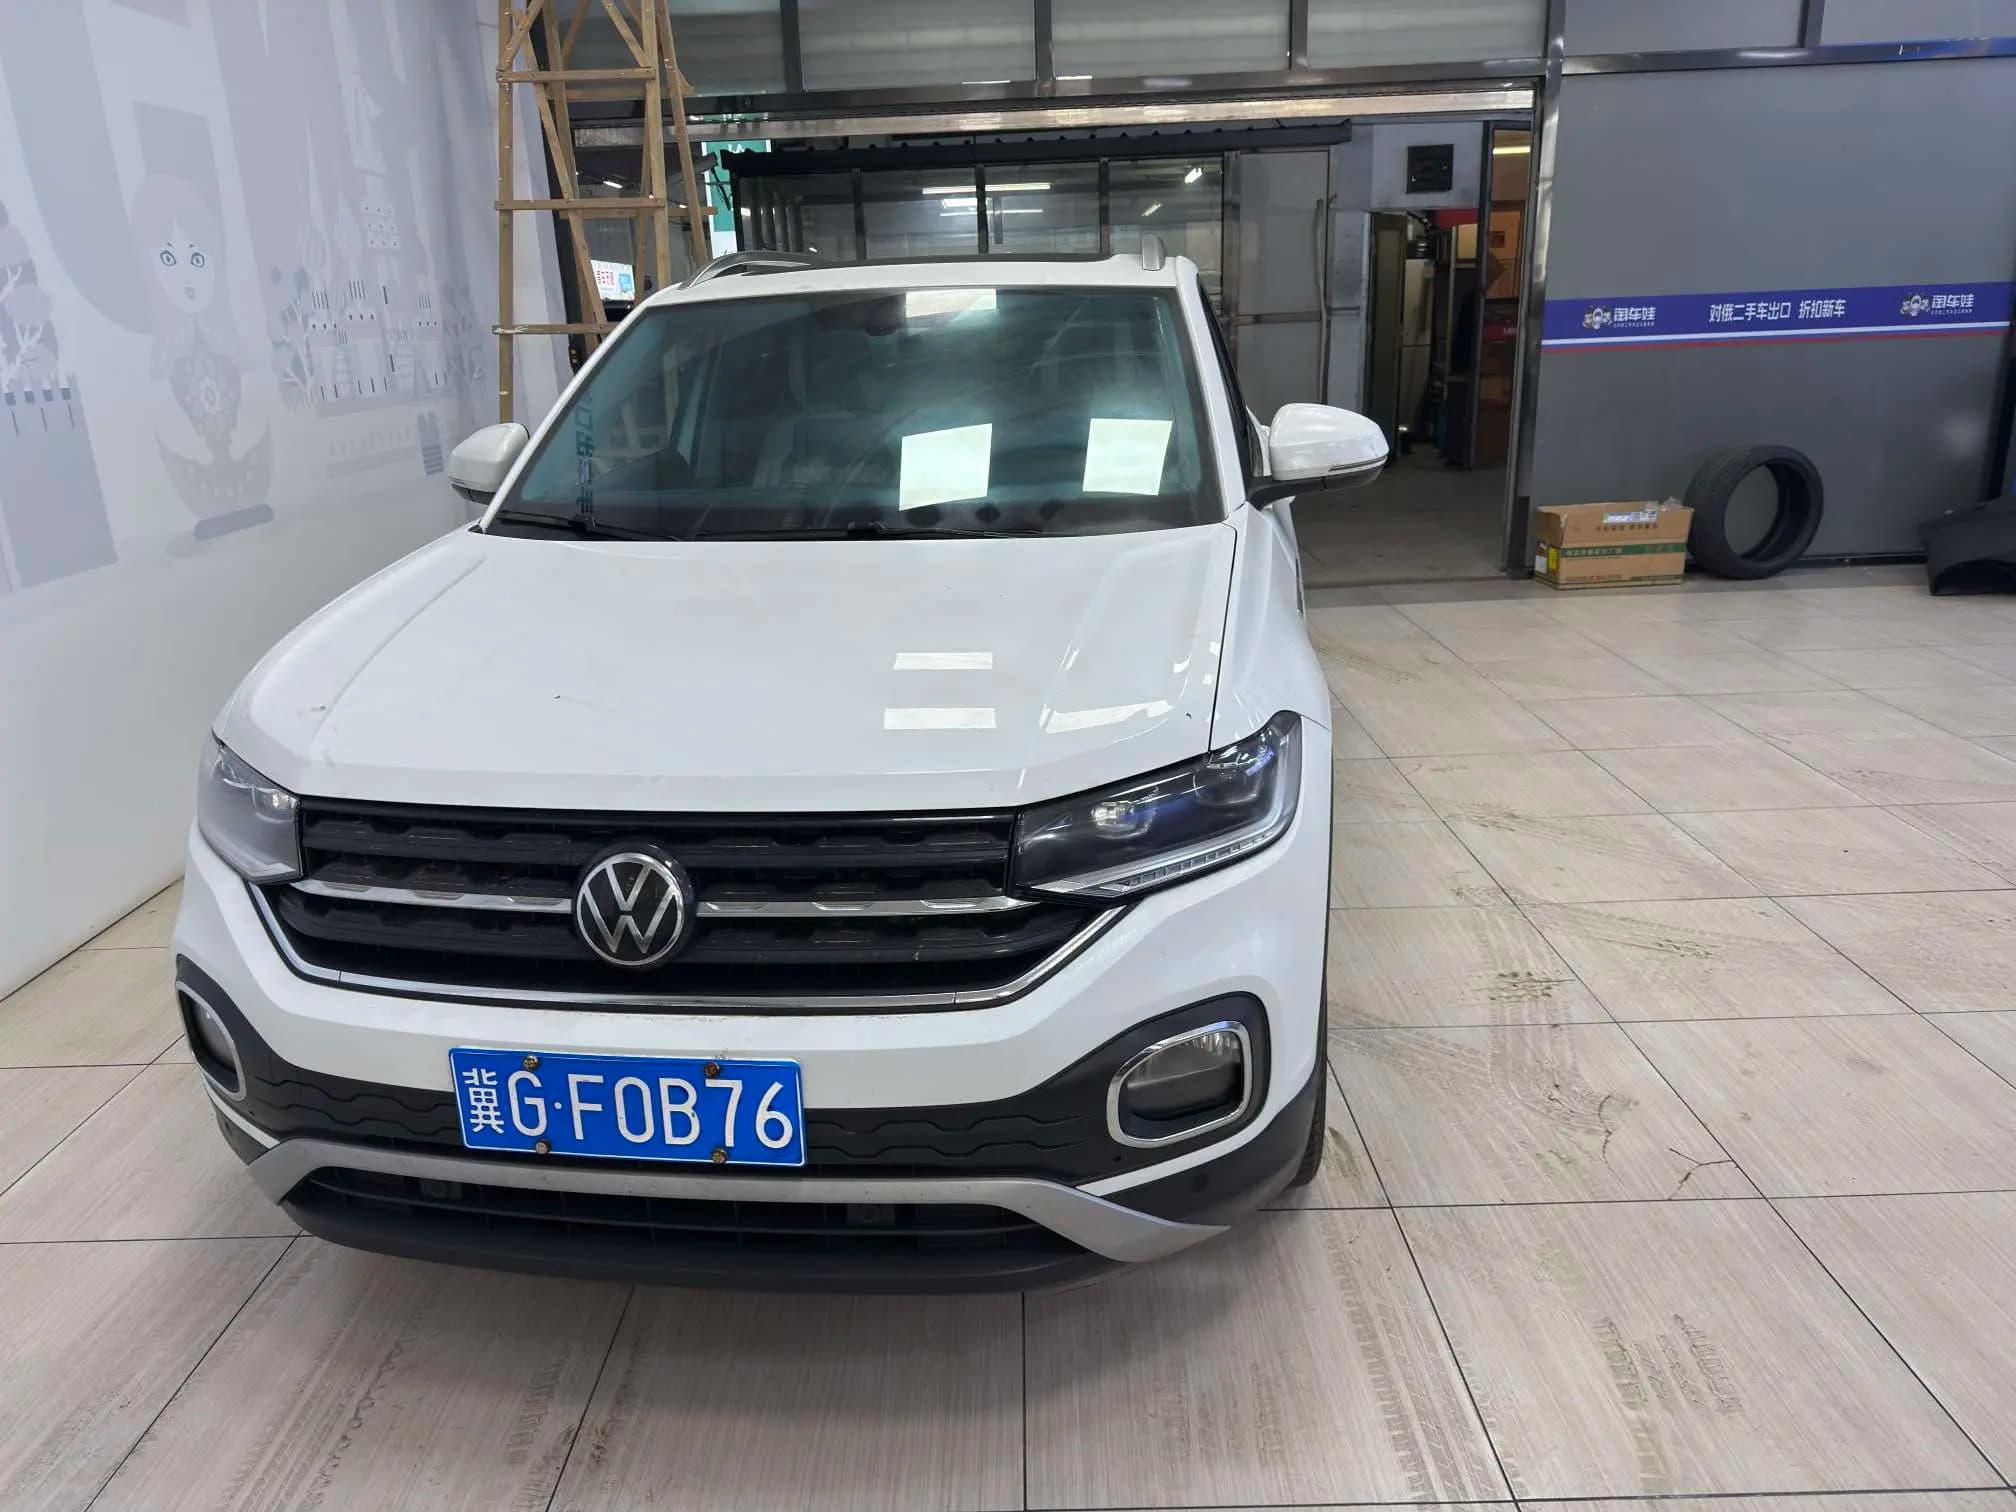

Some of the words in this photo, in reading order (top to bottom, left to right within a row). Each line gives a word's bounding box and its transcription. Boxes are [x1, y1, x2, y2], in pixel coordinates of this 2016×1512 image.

[1708, 301, 1792, 323] 对俄二手车出口
[1798, 299, 1847, 319] 折扣新车
